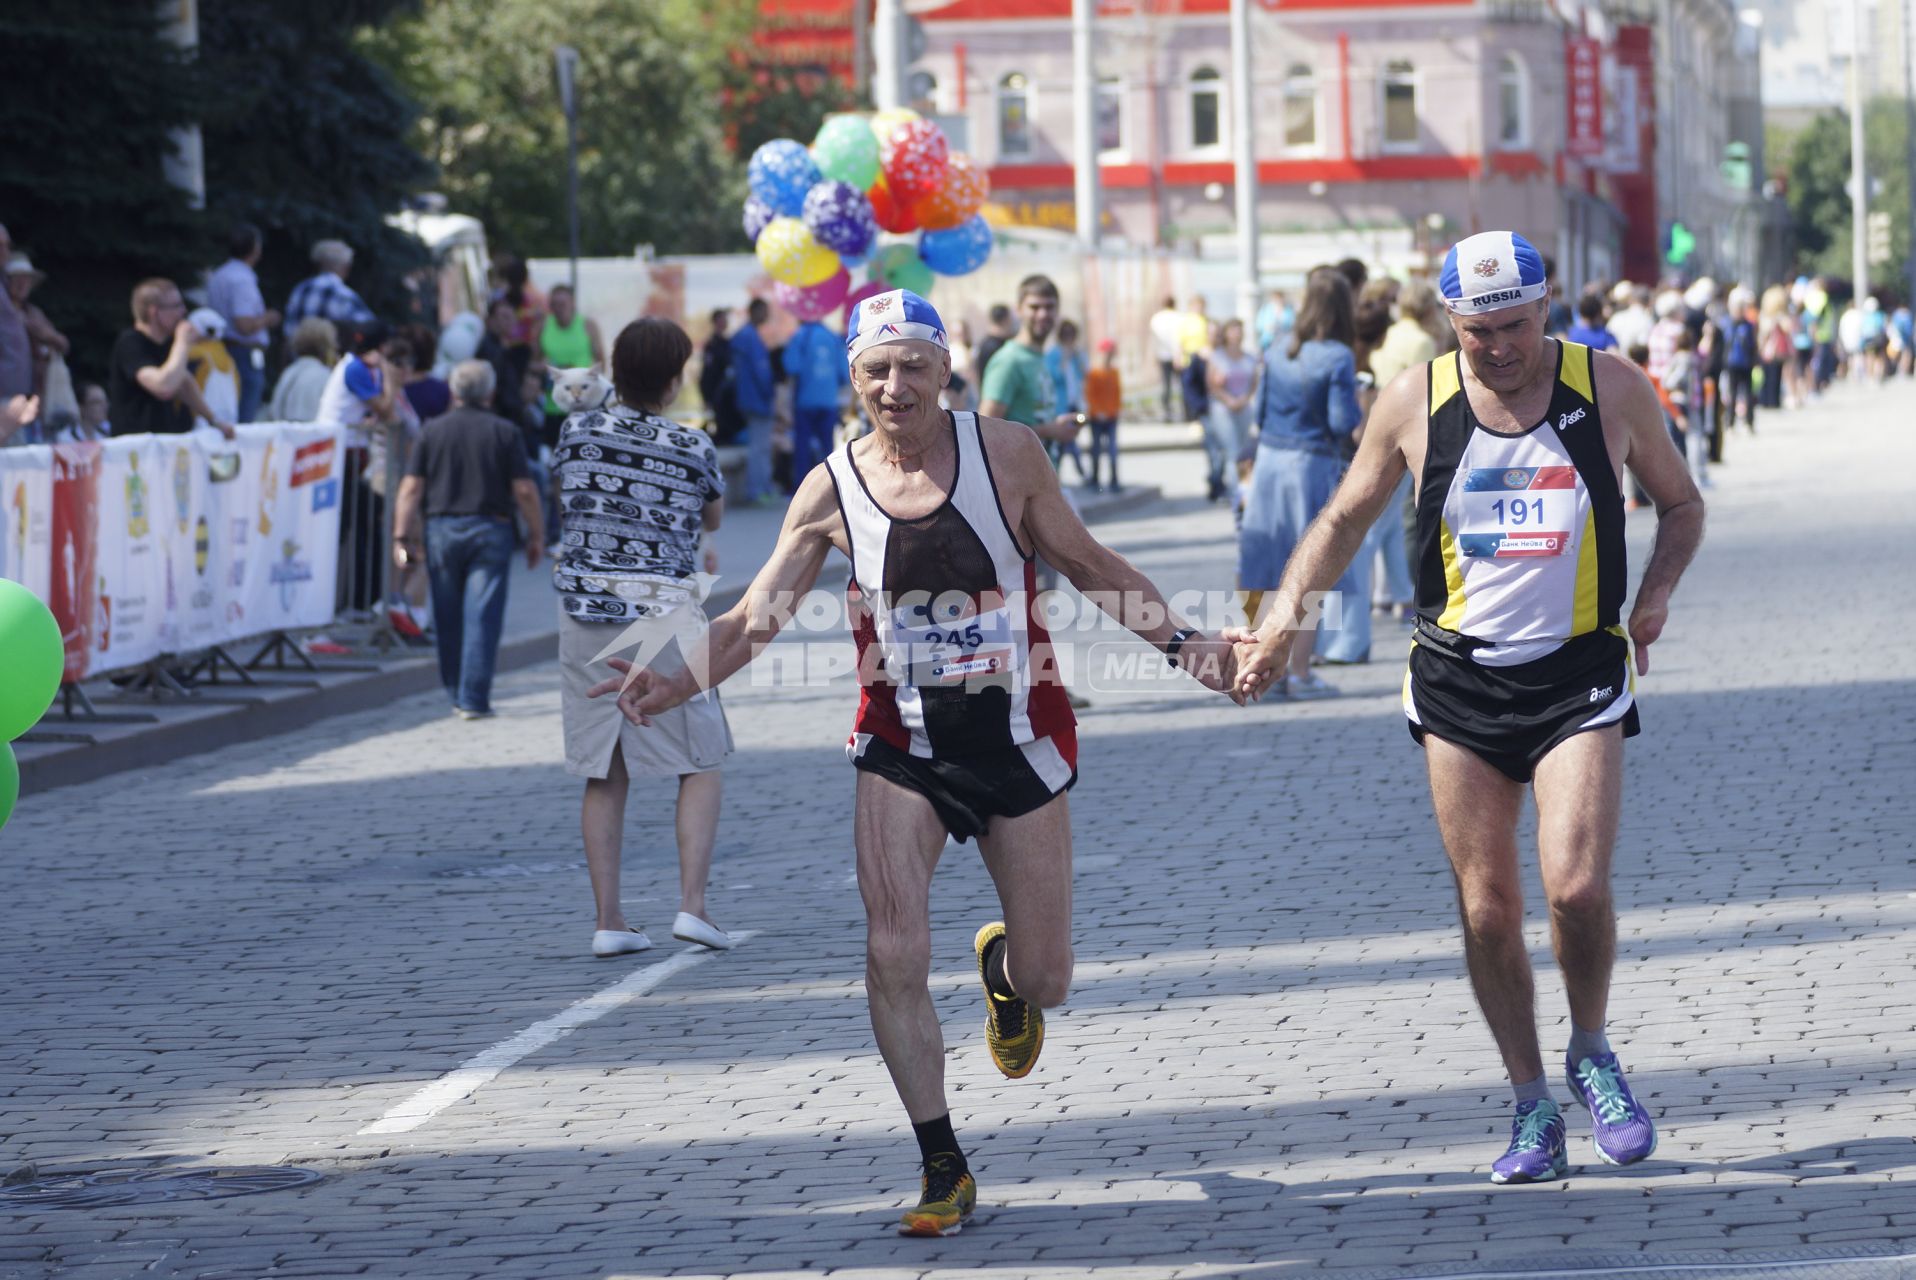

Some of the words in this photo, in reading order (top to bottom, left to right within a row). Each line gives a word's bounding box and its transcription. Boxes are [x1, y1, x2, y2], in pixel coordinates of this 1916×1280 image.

[1472, 290, 1522, 306] RUSSIA
[1492, 498, 1543, 525] 191
[925, 624, 984, 654] 245
